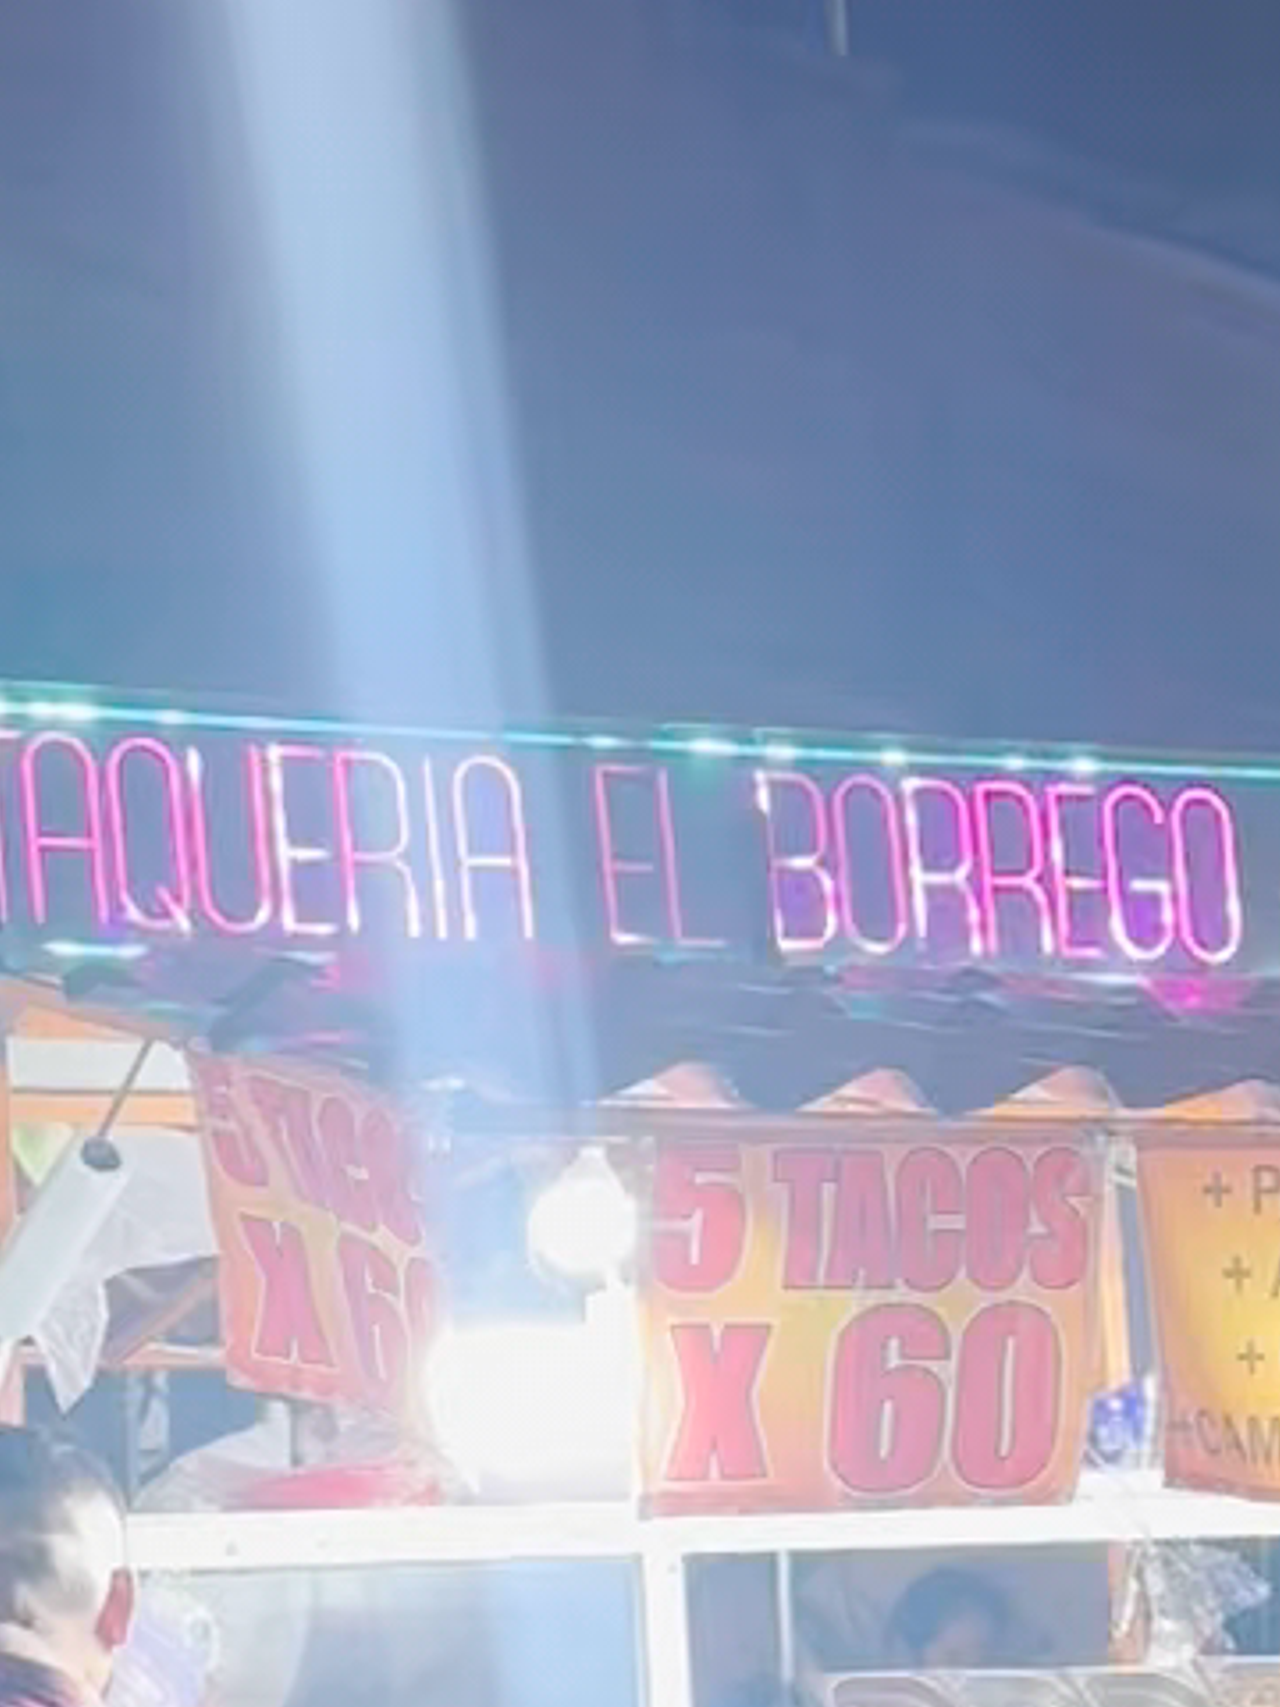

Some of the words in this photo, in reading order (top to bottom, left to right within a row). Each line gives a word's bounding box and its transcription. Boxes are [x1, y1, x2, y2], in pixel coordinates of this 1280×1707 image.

[593, 763, 725, 947] EL
[756, 769, 1241, 964] BORREGO
[239, 1213, 337, 1368] X
[652, 1145, 745, 1292] 5
[772, 1146, 1094, 1293] TACOS
[665, 1323, 768, 1481] X
[827, 1301, 1066, 1492] 60
